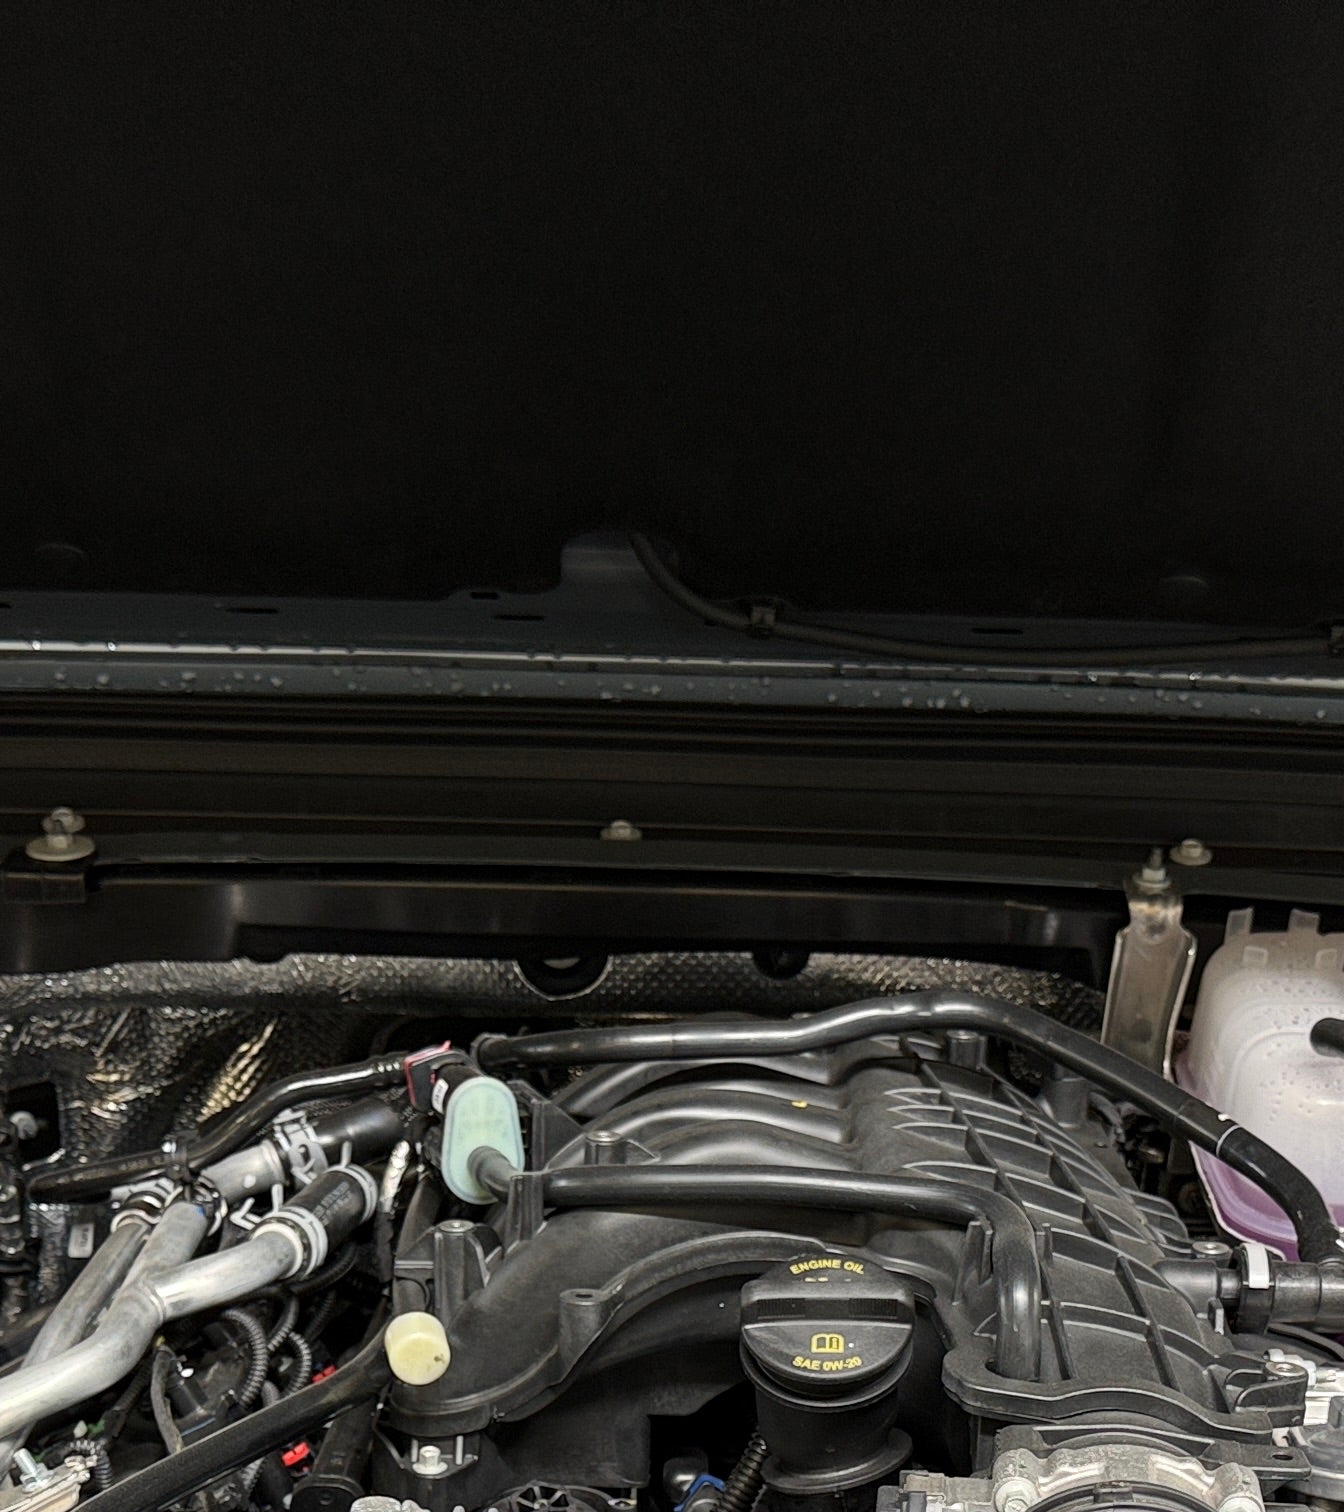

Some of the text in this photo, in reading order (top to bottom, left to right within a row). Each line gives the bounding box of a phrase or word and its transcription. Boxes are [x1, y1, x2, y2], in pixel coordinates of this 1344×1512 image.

[789, 1259, 865, 1275] ENGINE OIL
[792, 1356, 862, 1371] SAE 0W-20
